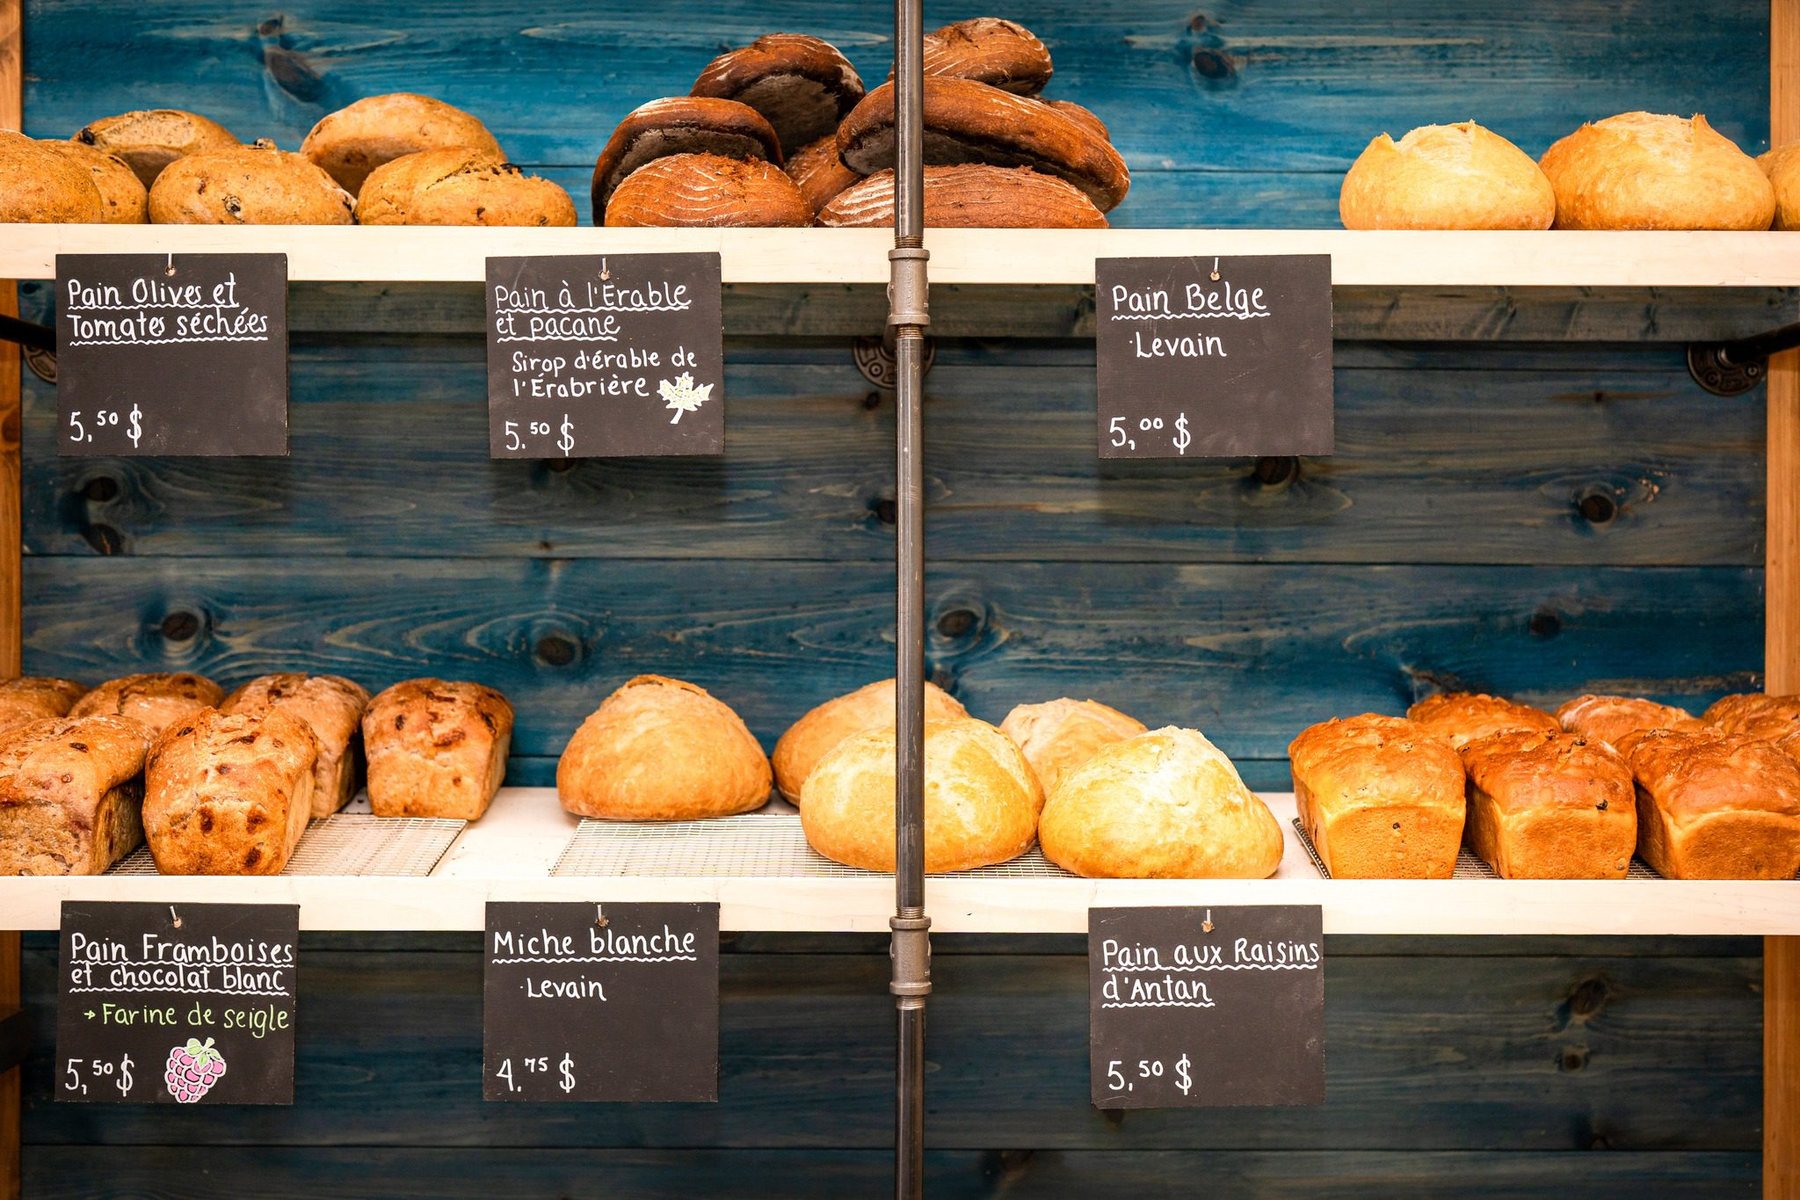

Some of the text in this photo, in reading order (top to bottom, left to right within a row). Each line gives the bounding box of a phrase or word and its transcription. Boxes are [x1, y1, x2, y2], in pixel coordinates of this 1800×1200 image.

[67, 272, 239, 307] Pain Olives et
[495, 285, 549, 309] Pain
[559, 280, 575, 308] à
[1112, 281, 1267, 320] Pain Belge
[67, 307, 268, 341] Tomates séchées
[496, 312, 621, 341] et pacane
[512, 345, 697, 377] Sirop d'érable de
[513, 373, 650, 398] l'Érabrière
[71, 932, 293, 963] Pain Framboises
[494, 924, 695, 955] Miche blanche
[1102, 937, 1319, 968] Pain aux Raisins
[71, 963, 285, 991] et chocolat blanc
[1102, 974, 1212, 1002] d'Antan
[102, 1001, 289, 1038] Farine de seigle
